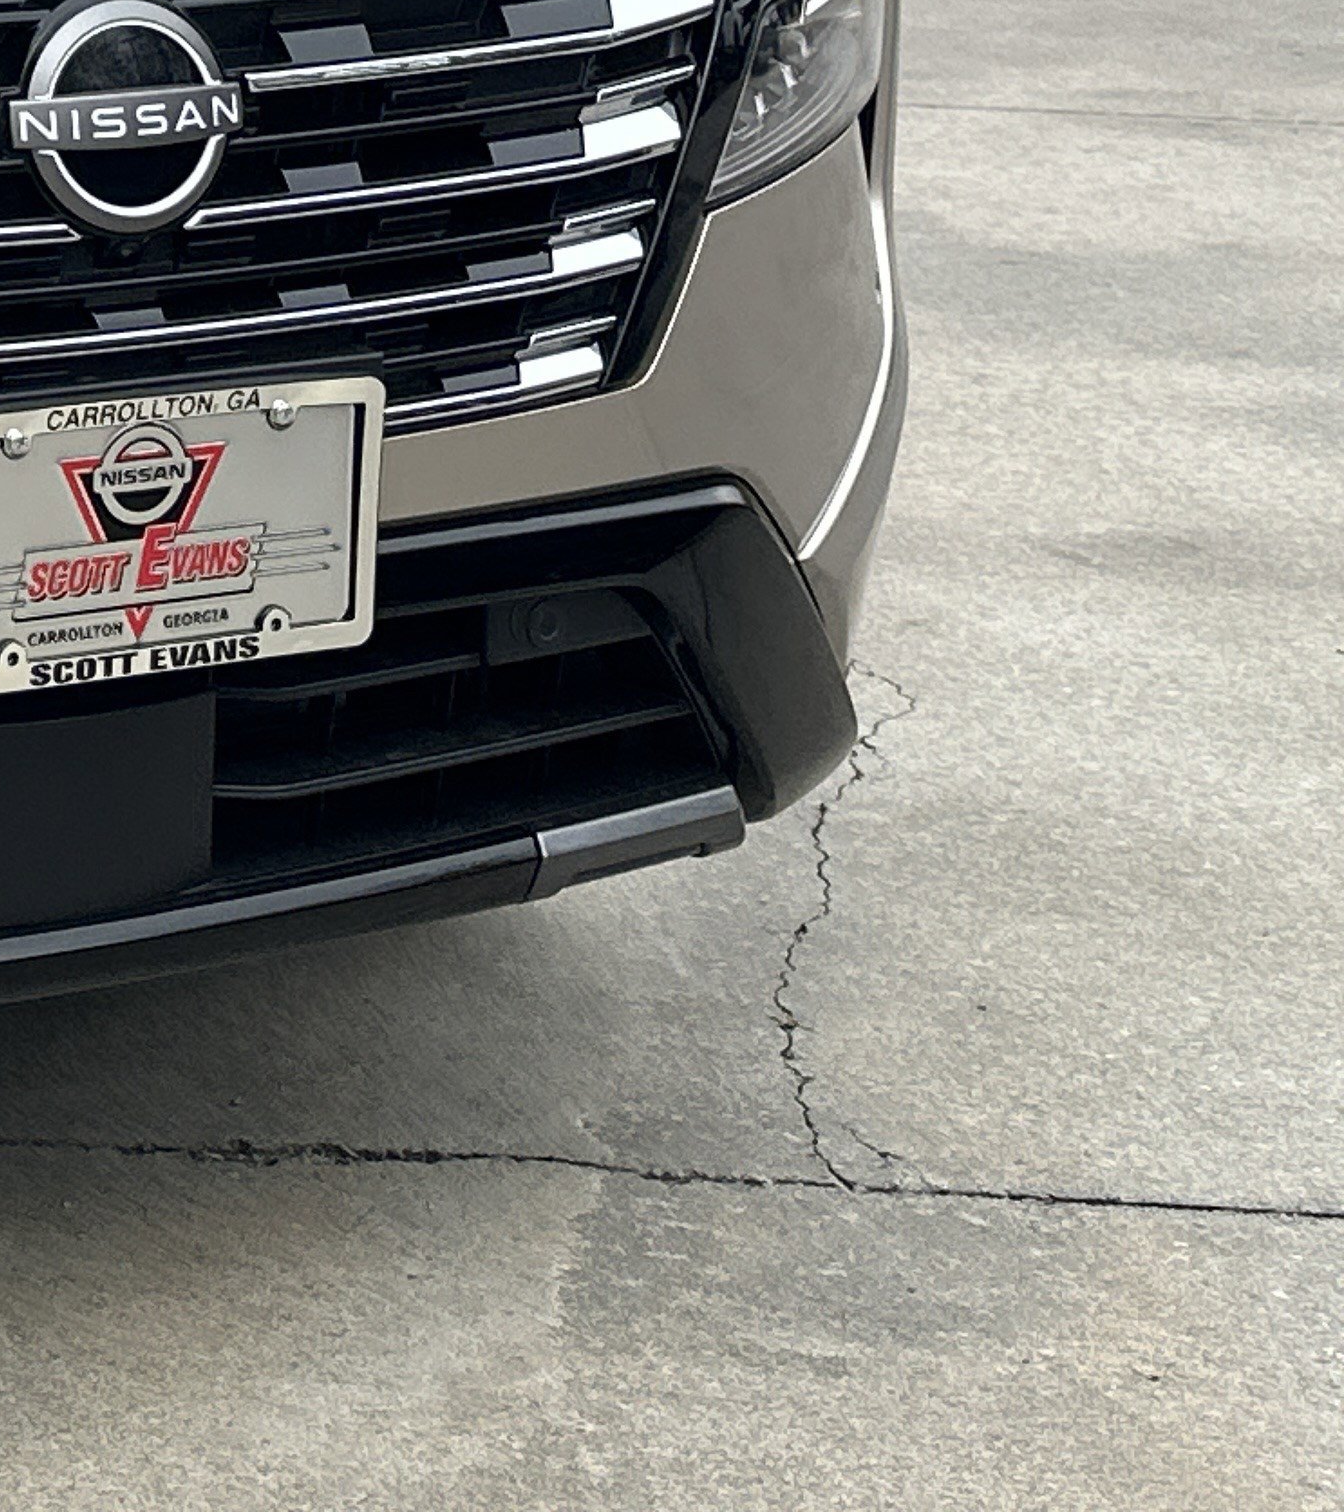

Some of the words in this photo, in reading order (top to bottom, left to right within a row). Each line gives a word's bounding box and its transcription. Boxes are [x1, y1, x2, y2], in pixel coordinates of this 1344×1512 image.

[18, 93, 239, 142] NISSAN
[226, 388, 261, 411] GA
[100, 463, 186, 487] NISSAN
[27, 552, 133, 603] SCOTT
[27, 621, 124, 647] CARROLLTON
[162, 607, 230, 629] GEORGIA
[29, 651, 139, 687] SCOTT
[150, 635, 261, 671] EVANS
